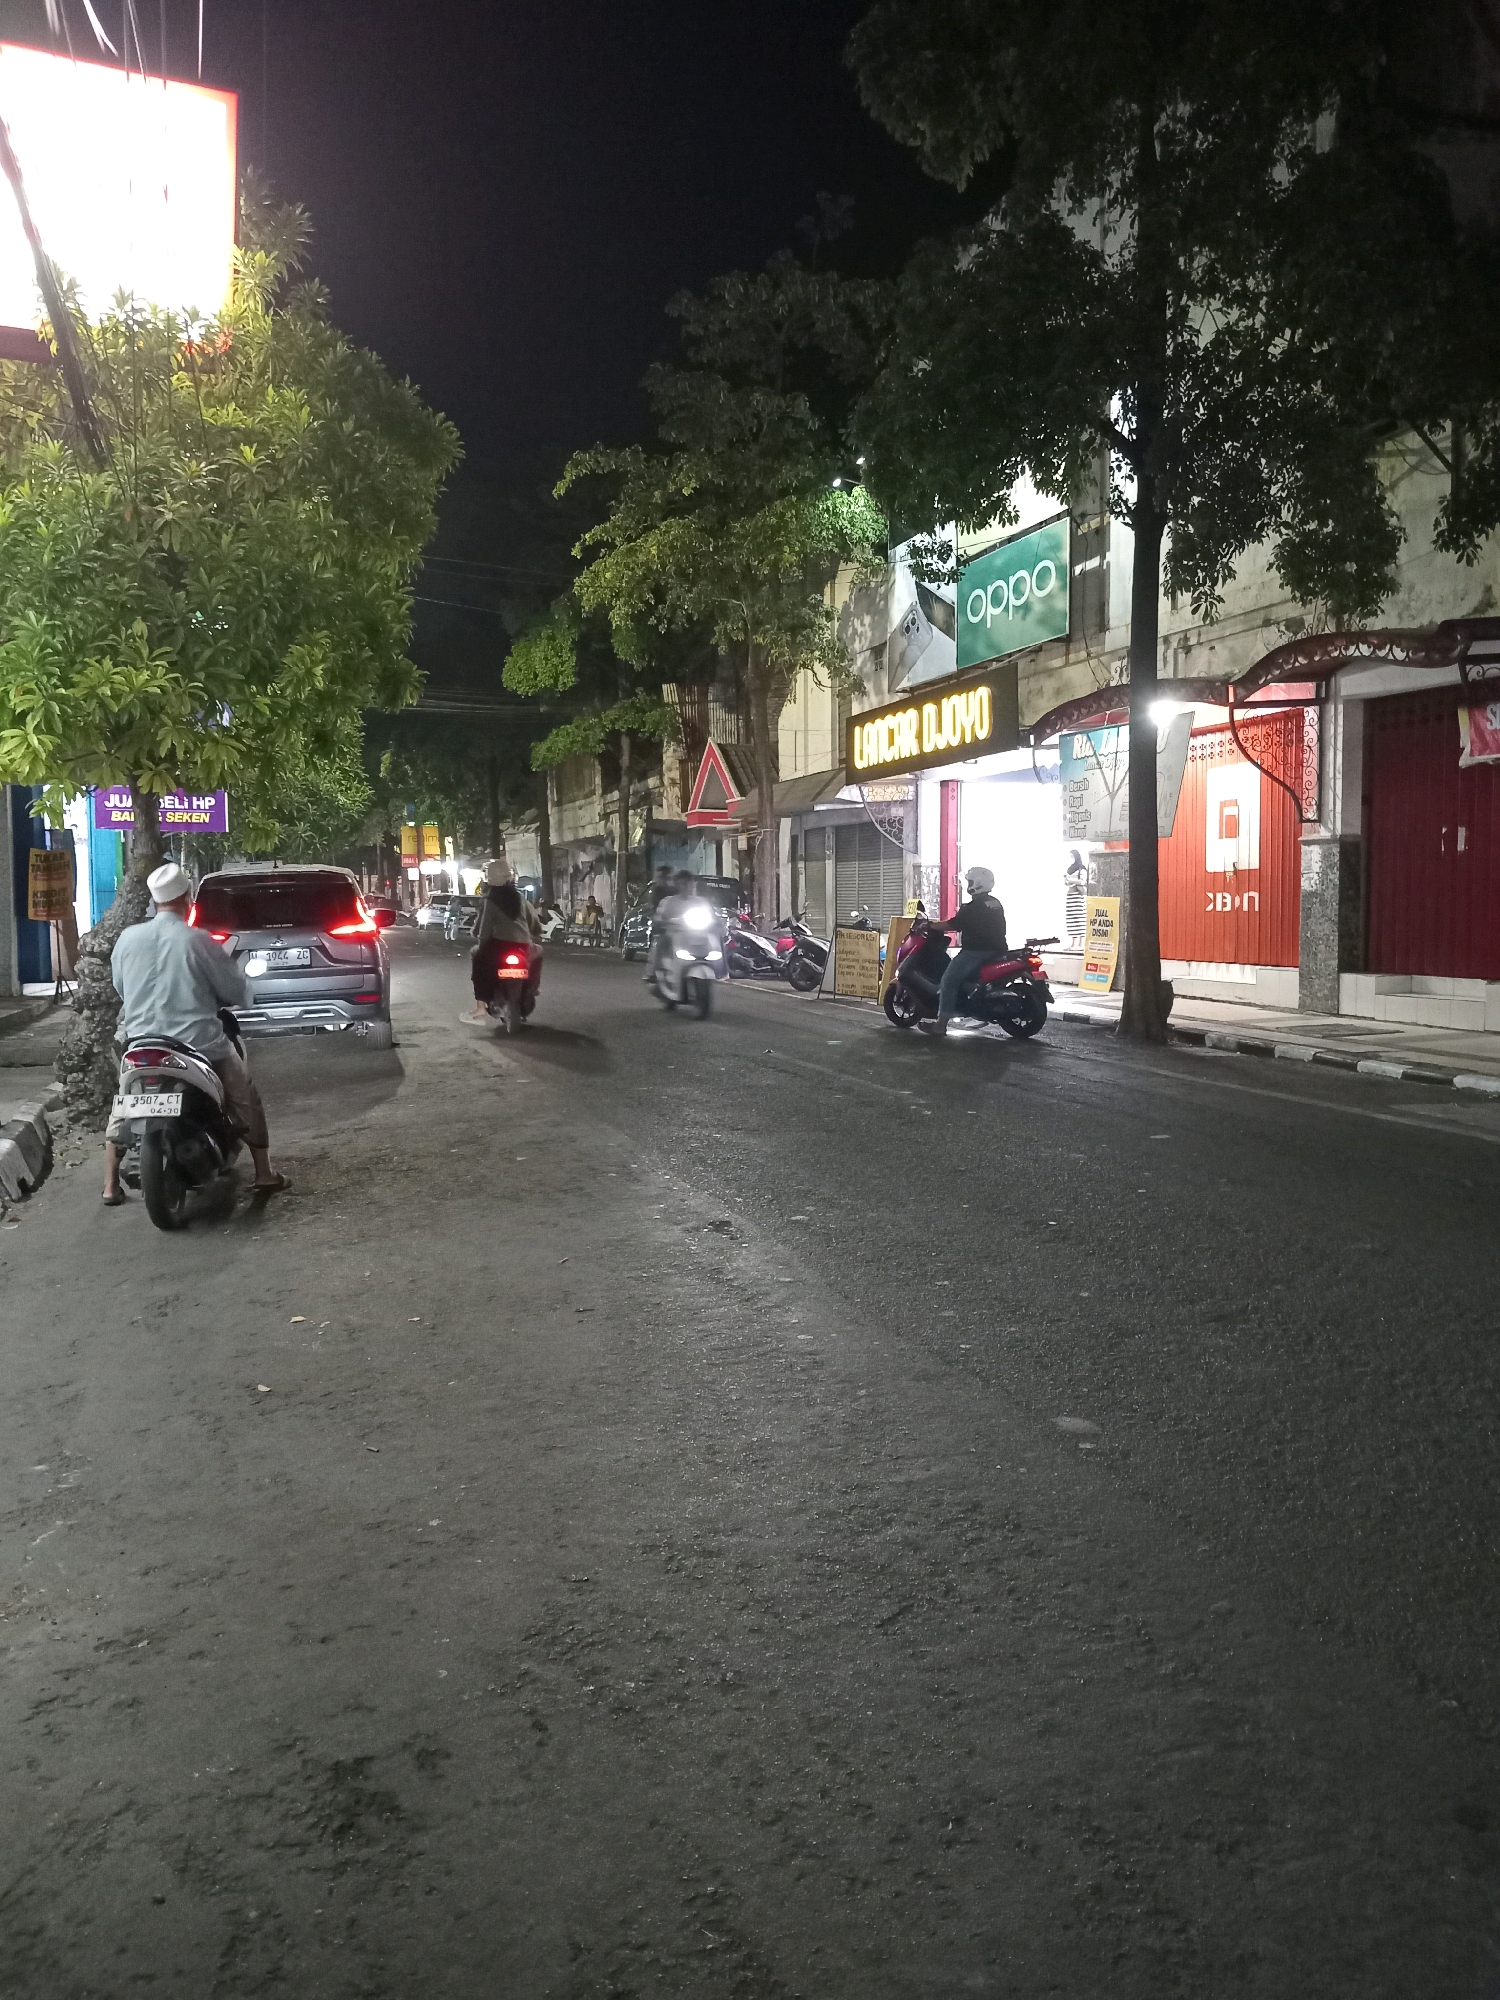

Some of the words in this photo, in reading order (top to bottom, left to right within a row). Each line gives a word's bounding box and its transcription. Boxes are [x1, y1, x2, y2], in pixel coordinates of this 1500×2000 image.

[967, 559, 1057, 629] oppo
[854, 708, 920, 769] LANCAR
[922, 686, 993, 753] DJOYO
[192, 796, 216, 810] HP
[165, 812, 210, 823] SEKEN
[266, 951, 289, 962] 1944
[133, 1095, 159, 1105] 3507
[166, 1094, 181, 1104] CT
